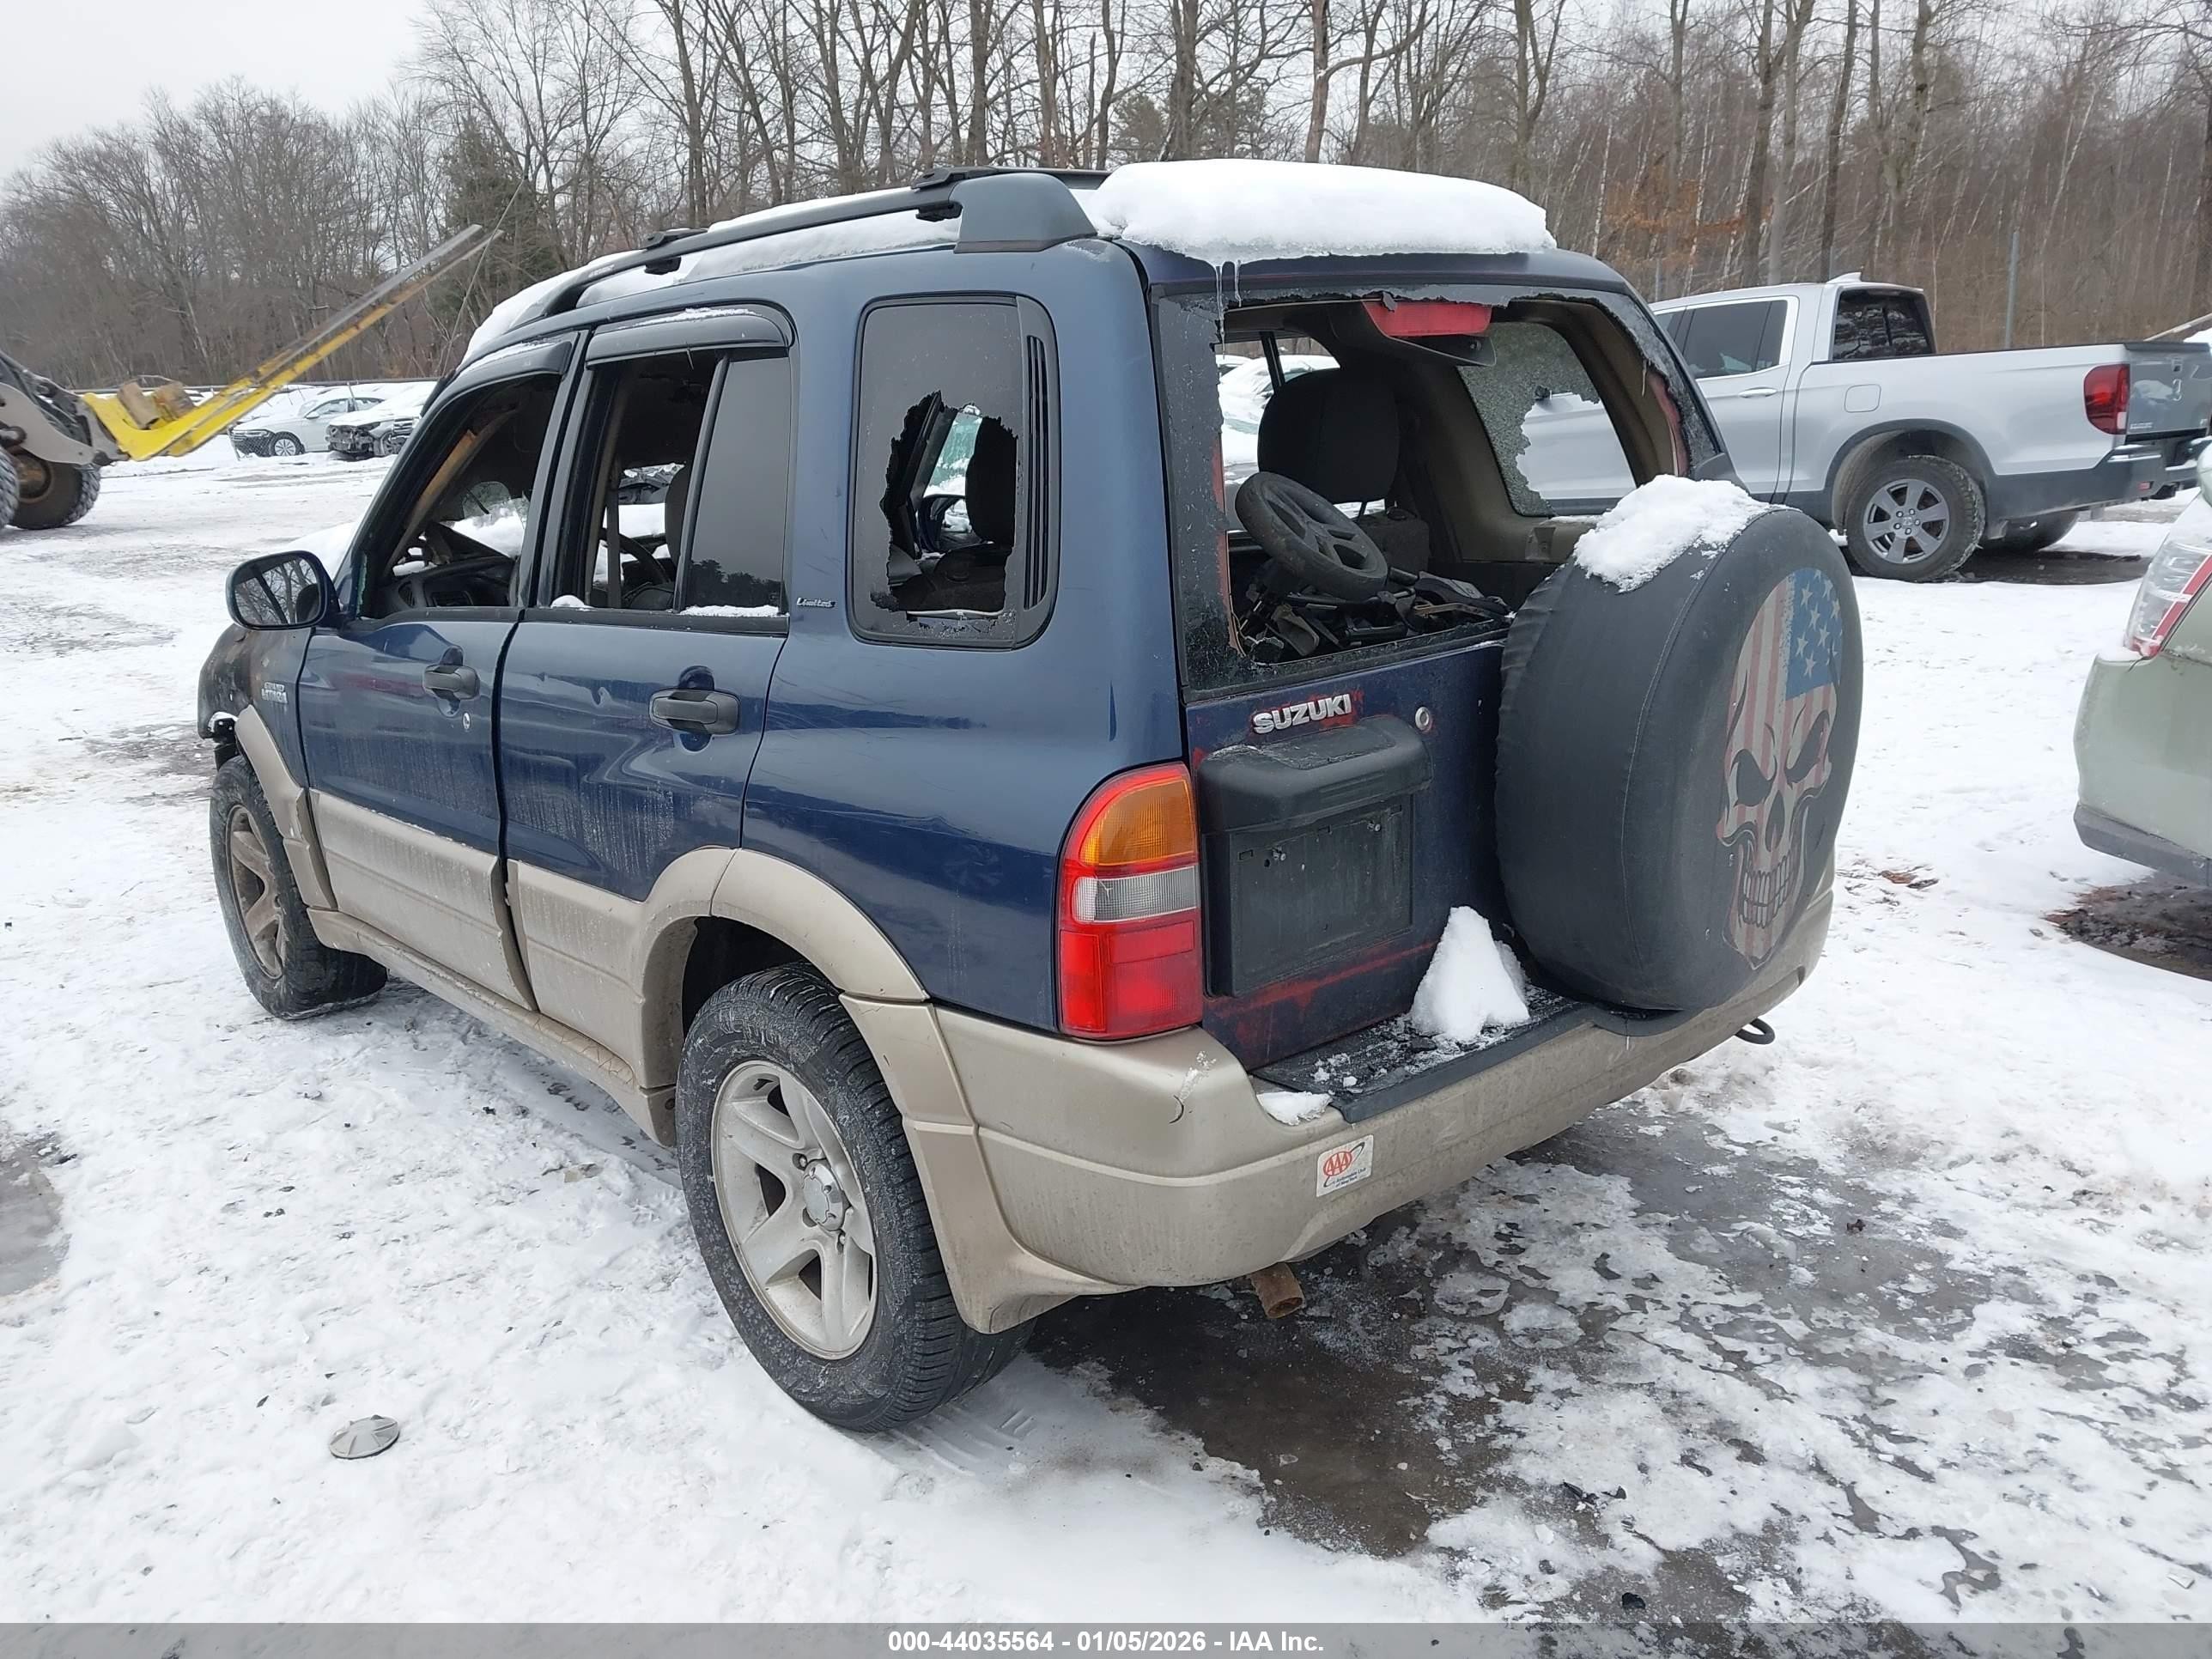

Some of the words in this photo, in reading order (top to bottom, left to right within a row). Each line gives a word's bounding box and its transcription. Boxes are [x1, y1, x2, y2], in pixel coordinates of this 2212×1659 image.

[796, 597, 833, 609] Limited
[1252, 693, 1352, 734] SUZUKI
[1326, 1152, 1351, 1176] AAA
